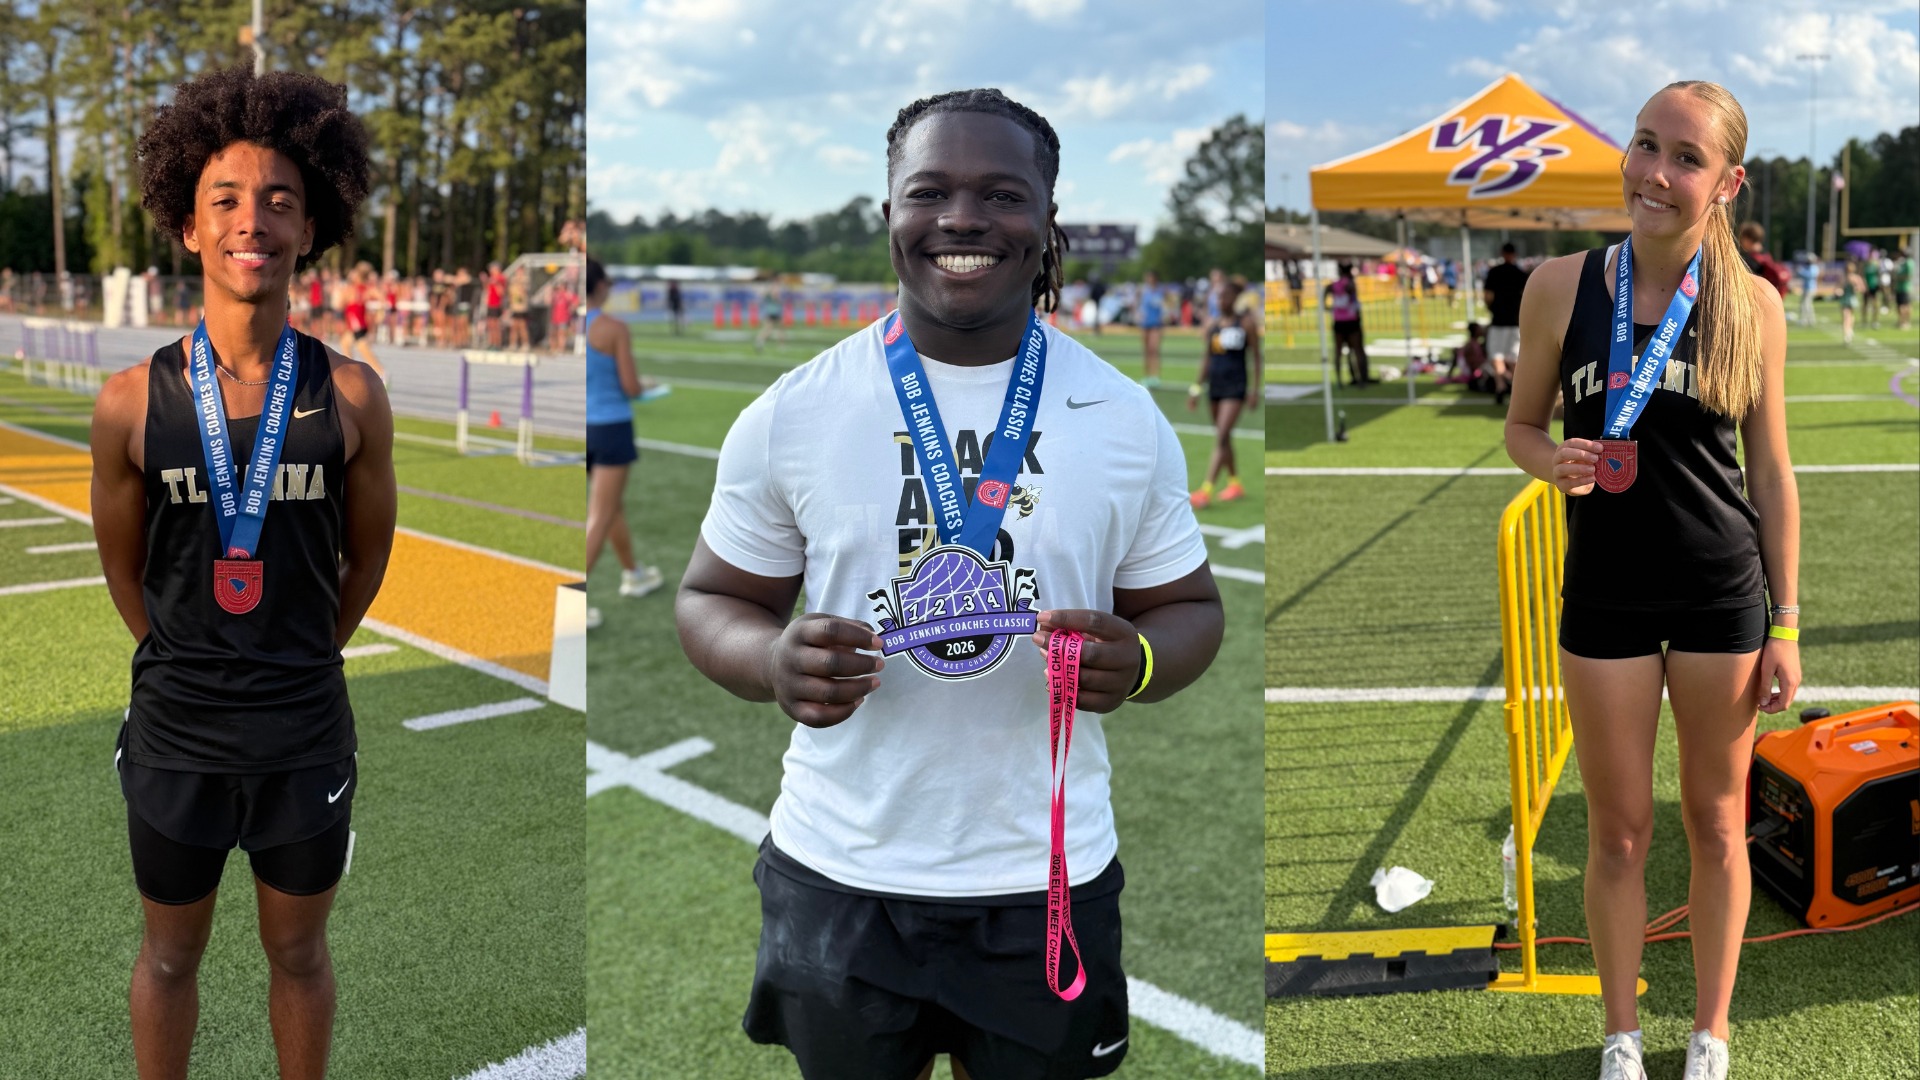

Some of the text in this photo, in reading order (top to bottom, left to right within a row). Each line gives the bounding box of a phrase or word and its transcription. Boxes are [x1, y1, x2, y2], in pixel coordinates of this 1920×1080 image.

[1619, 278, 1629, 319] JENKINS
[1616, 321, 1627, 343] BOB
[1003, 329, 1043, 440] COACHES CLASSIC
[1571, 361, 1603, 403] TL
[1609, 400, 1637, 438] JENKINS
[1630, 356, 1660, 399] COACHES
[1652, 318, 1678, 358] CLASSIC
[200, 383, 221, 436] COACHES
[245, 338, 294, 514] BOB JENKINS COACHES CLASSIC
[210, 439, 232, 489] JENKINS
[901, 372, 963, 530] BOB JENKINS COACHES
[161, 467, 207, 503] TL
[221, 492, 237, 517] BOB
[908, 591, 1001, 622] 1 2 3 4
[885, 618, 1031, 648] BOB JENKINS COACHES CLASSIC
[946, 640, 976, 656] 2026
[918, 638, 1003, 670] ELITE MEET CHAMPION
[1067, 637, 1080, 662] 2026
[1053, 675, 1062, 705] MEET
[1066, 664, 1076, 695] ELITE
[1065, 695, 1074, 727] MEET
[1052, 854, 1061, 876] 2026
[1051, 878, 1061, 907] ELITE
[1050, 909, 1059, 938] MEET
